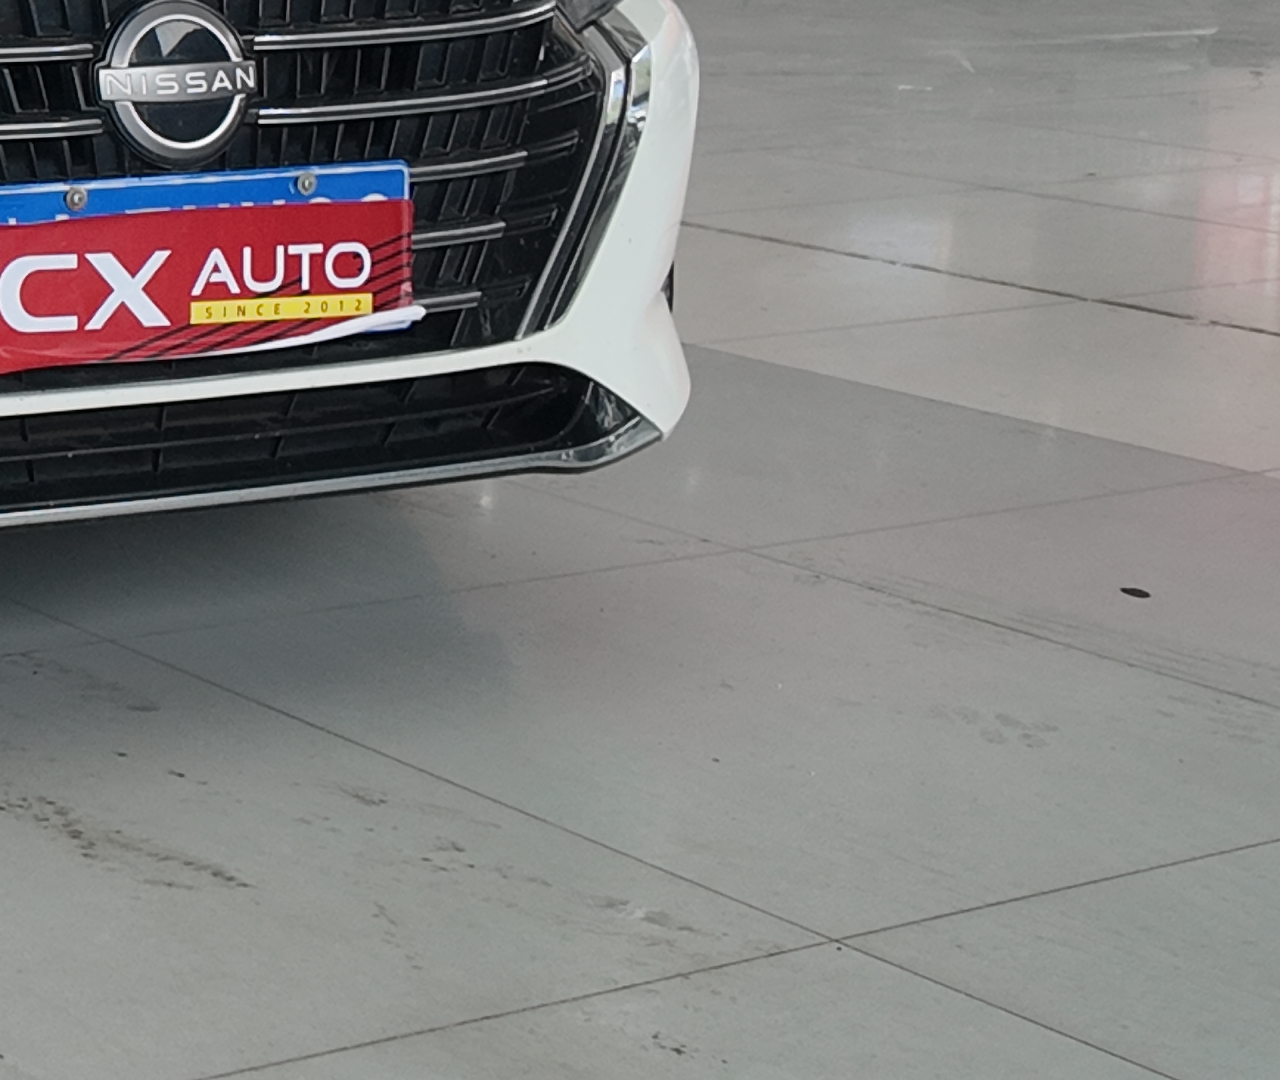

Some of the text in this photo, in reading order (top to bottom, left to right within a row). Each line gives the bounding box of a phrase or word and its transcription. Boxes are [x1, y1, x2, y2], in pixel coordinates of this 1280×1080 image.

[104, 60, 256, 98] NISSAN
[191, 241, 373, 296] AUTO
[204, 298, 365, 319] SINCE 2012
